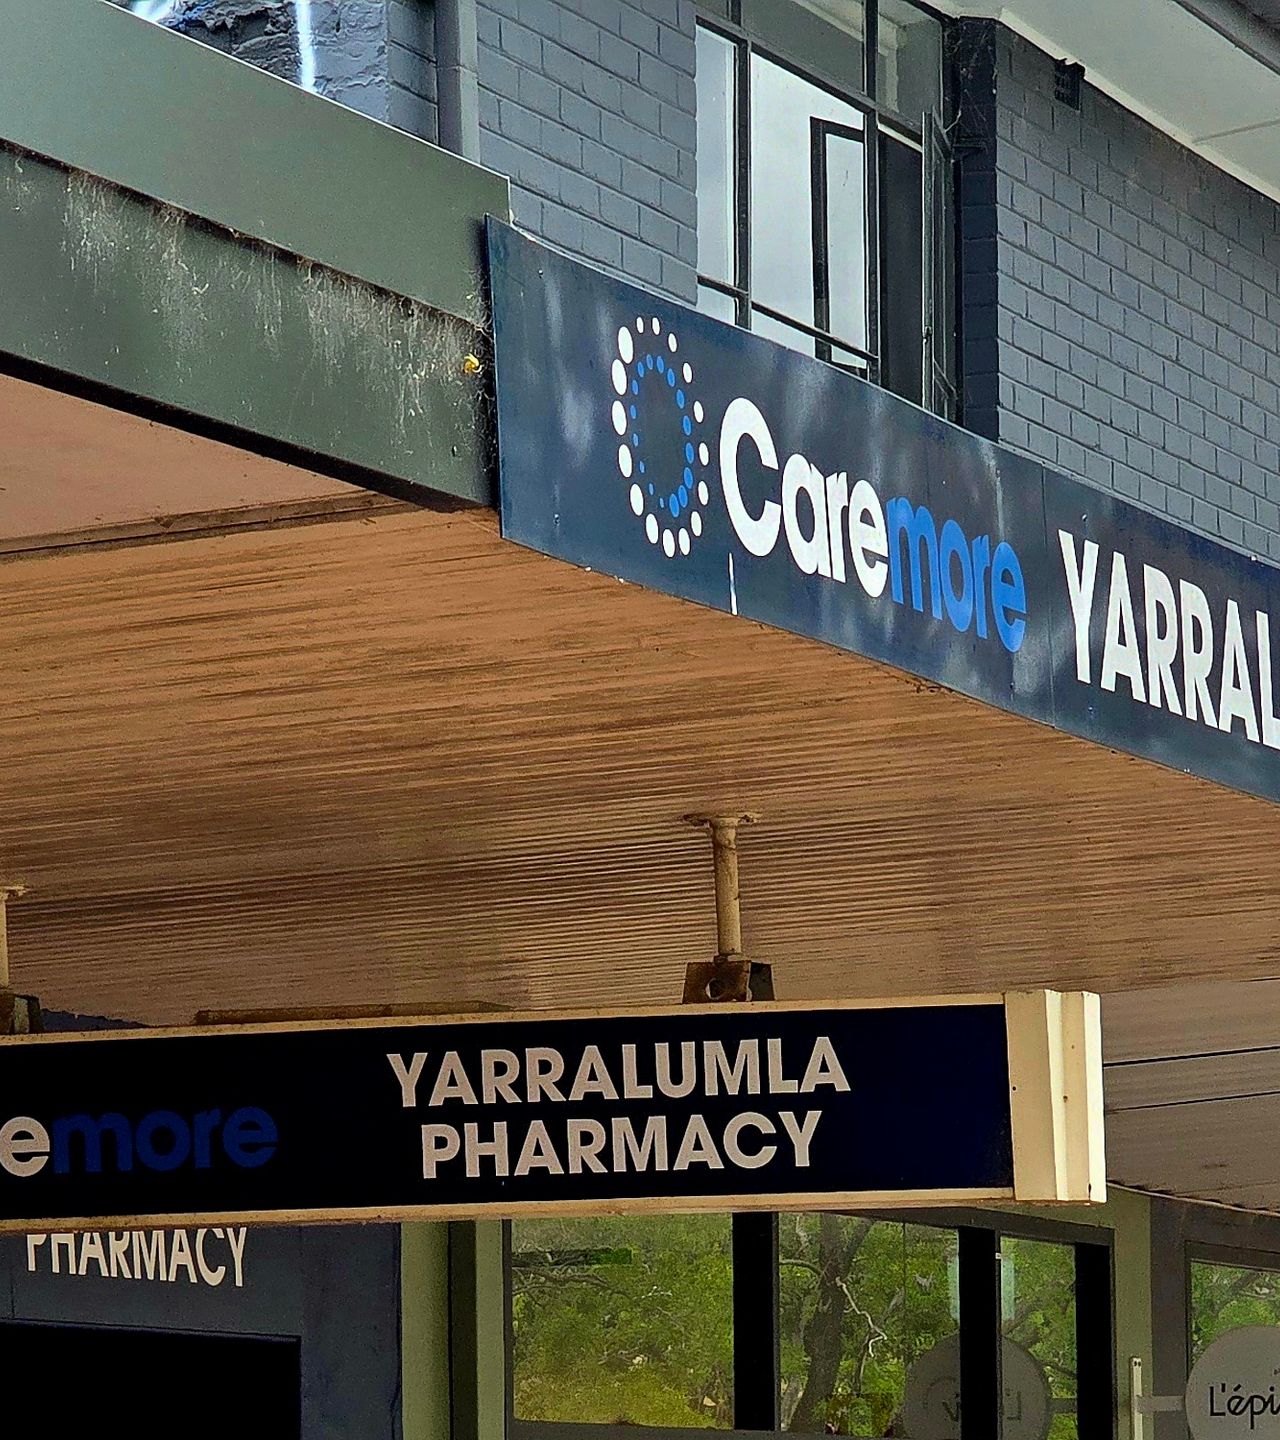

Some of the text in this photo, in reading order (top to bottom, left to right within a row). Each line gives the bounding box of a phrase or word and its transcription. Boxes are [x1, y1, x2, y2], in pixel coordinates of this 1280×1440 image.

[720, 397, 1027, 653] Caremore
[386, 1036, 851, 1108] YARRALUMLA
[421, 1110, 822, 1179] PHARMACY
